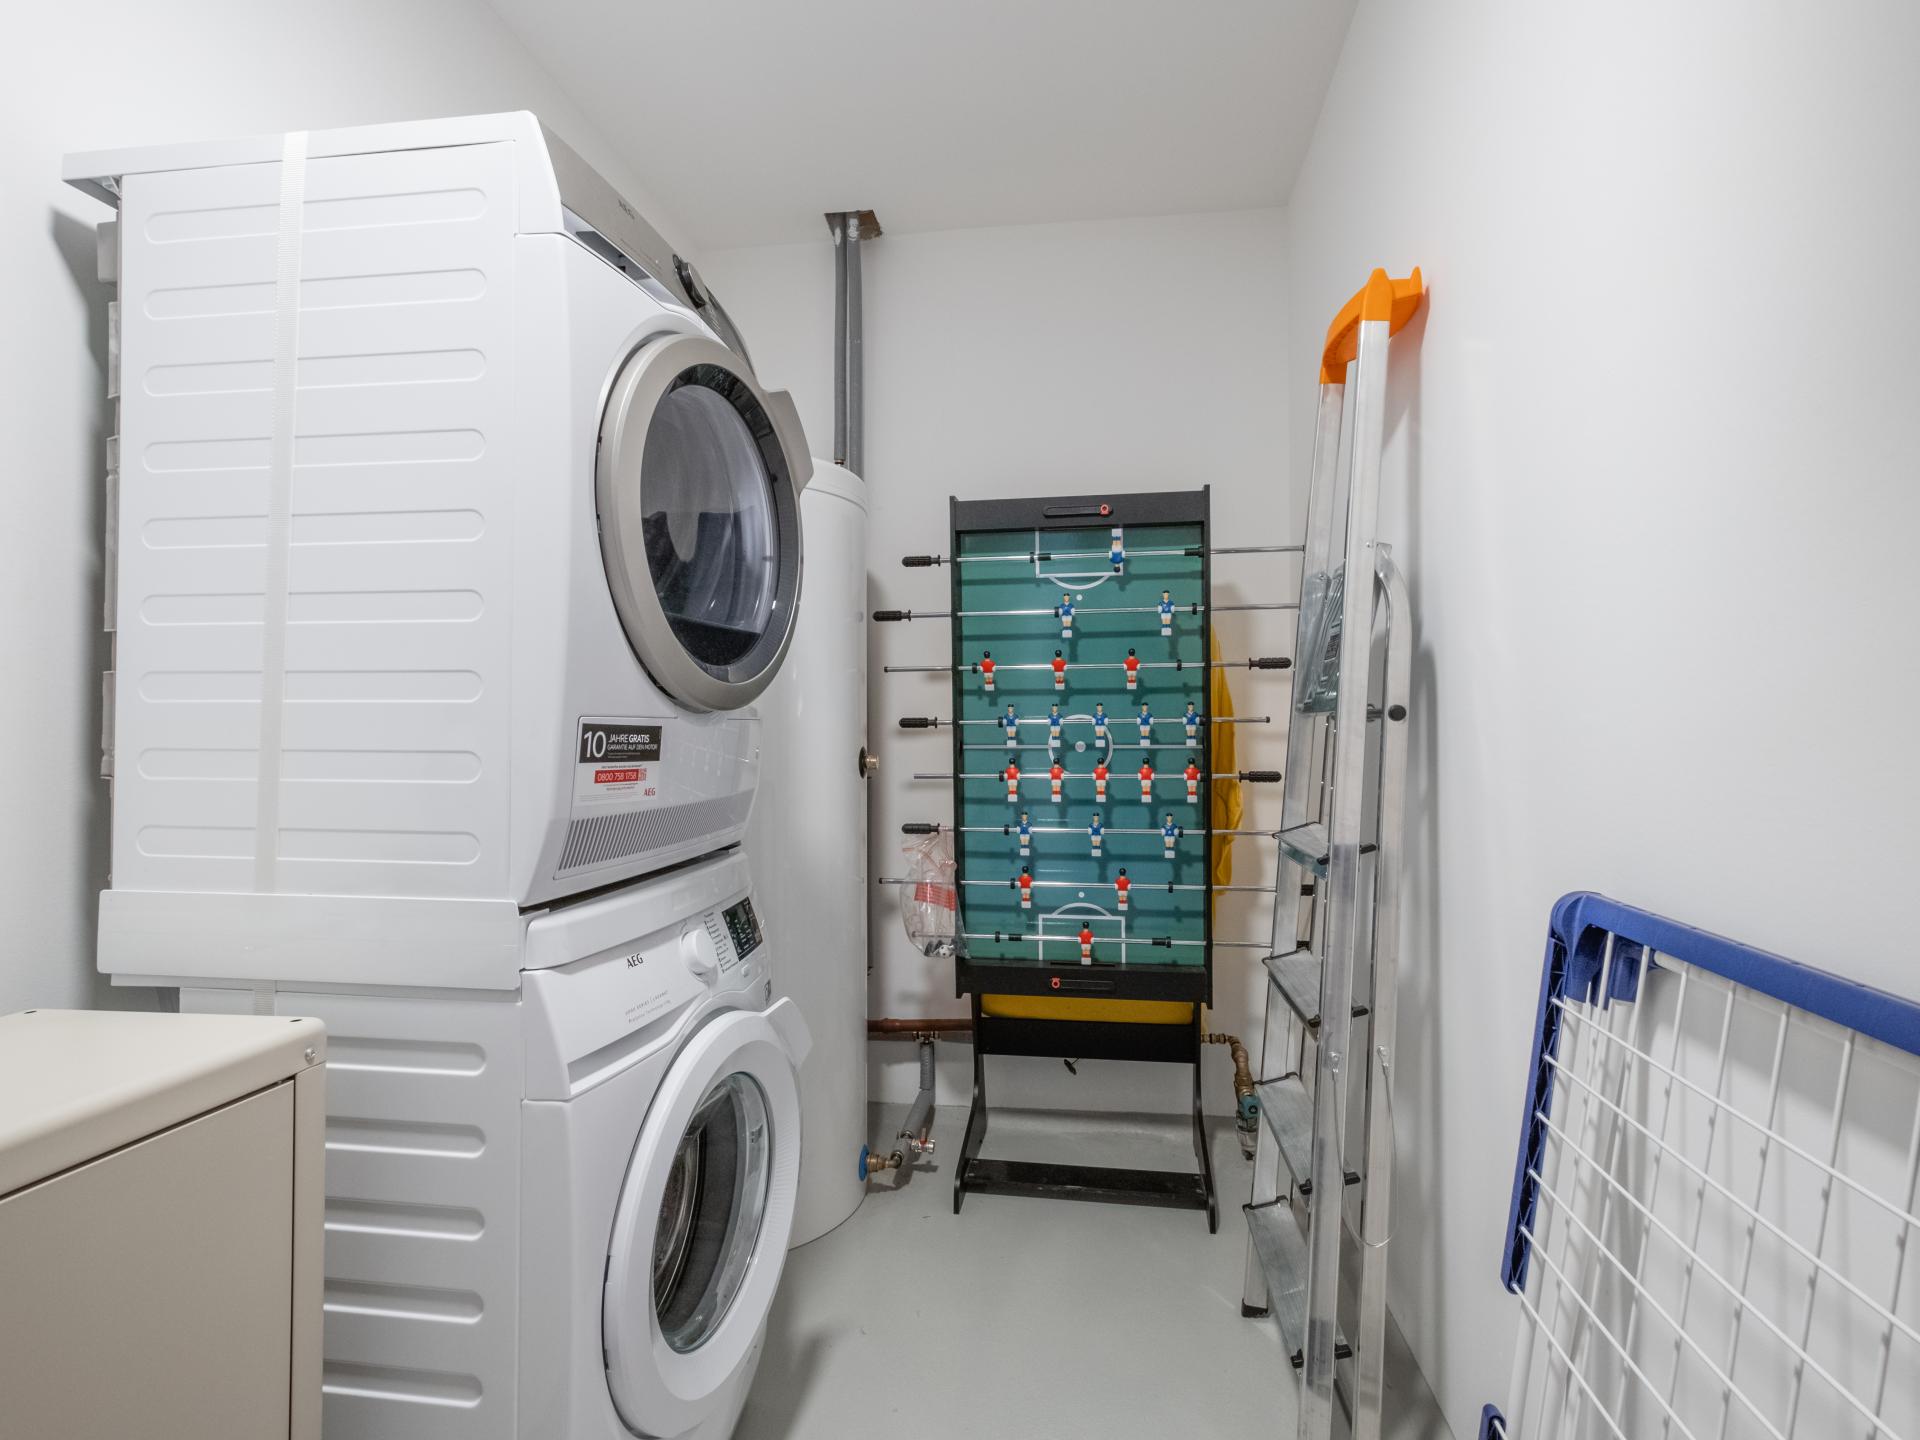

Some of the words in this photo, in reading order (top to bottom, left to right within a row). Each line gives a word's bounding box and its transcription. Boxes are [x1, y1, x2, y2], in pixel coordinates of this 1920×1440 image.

[608, 734, 628, 743] JAHRE
[628, 734, 650, 743] GRATIS
[583, 731, 607, 758] 10
[597, 773, 614, 782] 0800
[614, 772, 625, 780] 758
[643, 787, 656, 796] AEG
[626, 953, 644, 969] AEG
